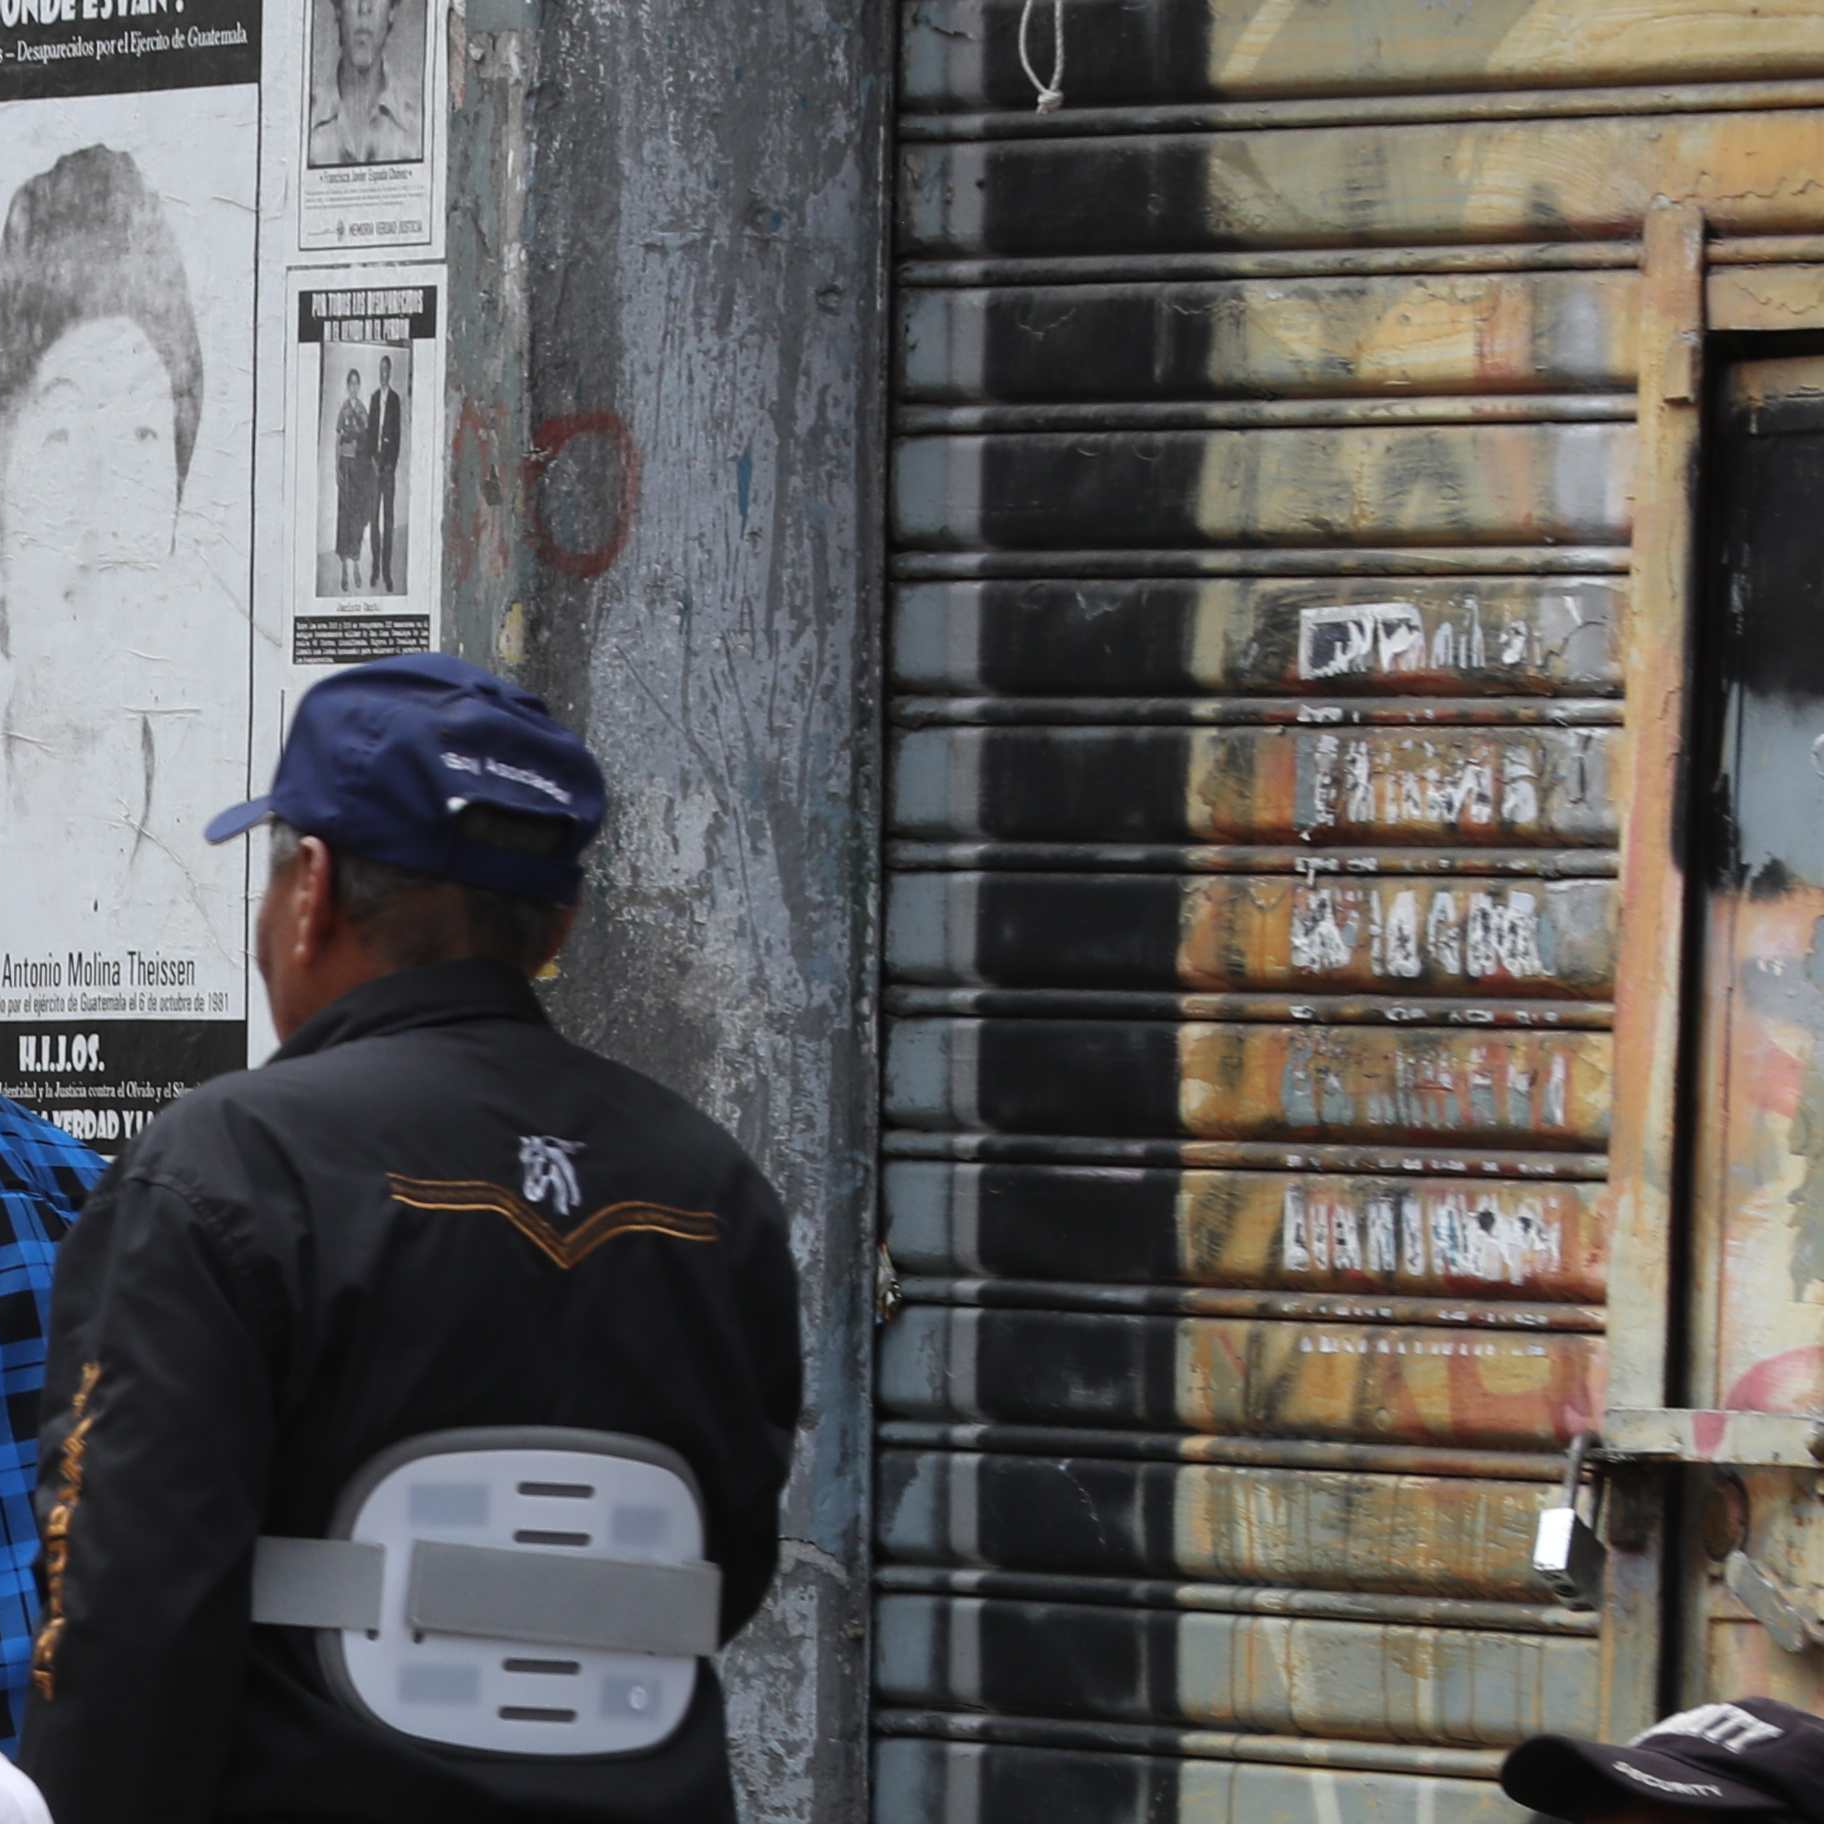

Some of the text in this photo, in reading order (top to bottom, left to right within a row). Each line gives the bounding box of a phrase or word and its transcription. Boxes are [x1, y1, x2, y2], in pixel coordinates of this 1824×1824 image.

[17, 36, 94, 65] Desaparecidos
[96, 38, 116, 60] por
[118, 31, 128, 54] el
[172, 27, 185, 49] de
[187, 21, 248, 49] Guatemala
[2, 951, 62, 988] Antonio
[67, 951, 121, 988] Molina
[127, 950, 195, 987] Theissen
[24, 993, 32, 1013] el
[67, 994, 78, 1012] de
[80, 992, 126, 1012] Guatemala
[129, 993, 137, 1012] el
[139, 992, 145, 1012] 6
[147, 993, 157, 1012] de
[160, 993, 192, 1012] octubre
[194, 993, 205, 1012] de
[55, 1080, 87, 1099] Justicia
[88, 1084, 116, 1098] contra
[117, 1080, 125, 1098] el
[126, 1080, 155, 1098] Olvido
